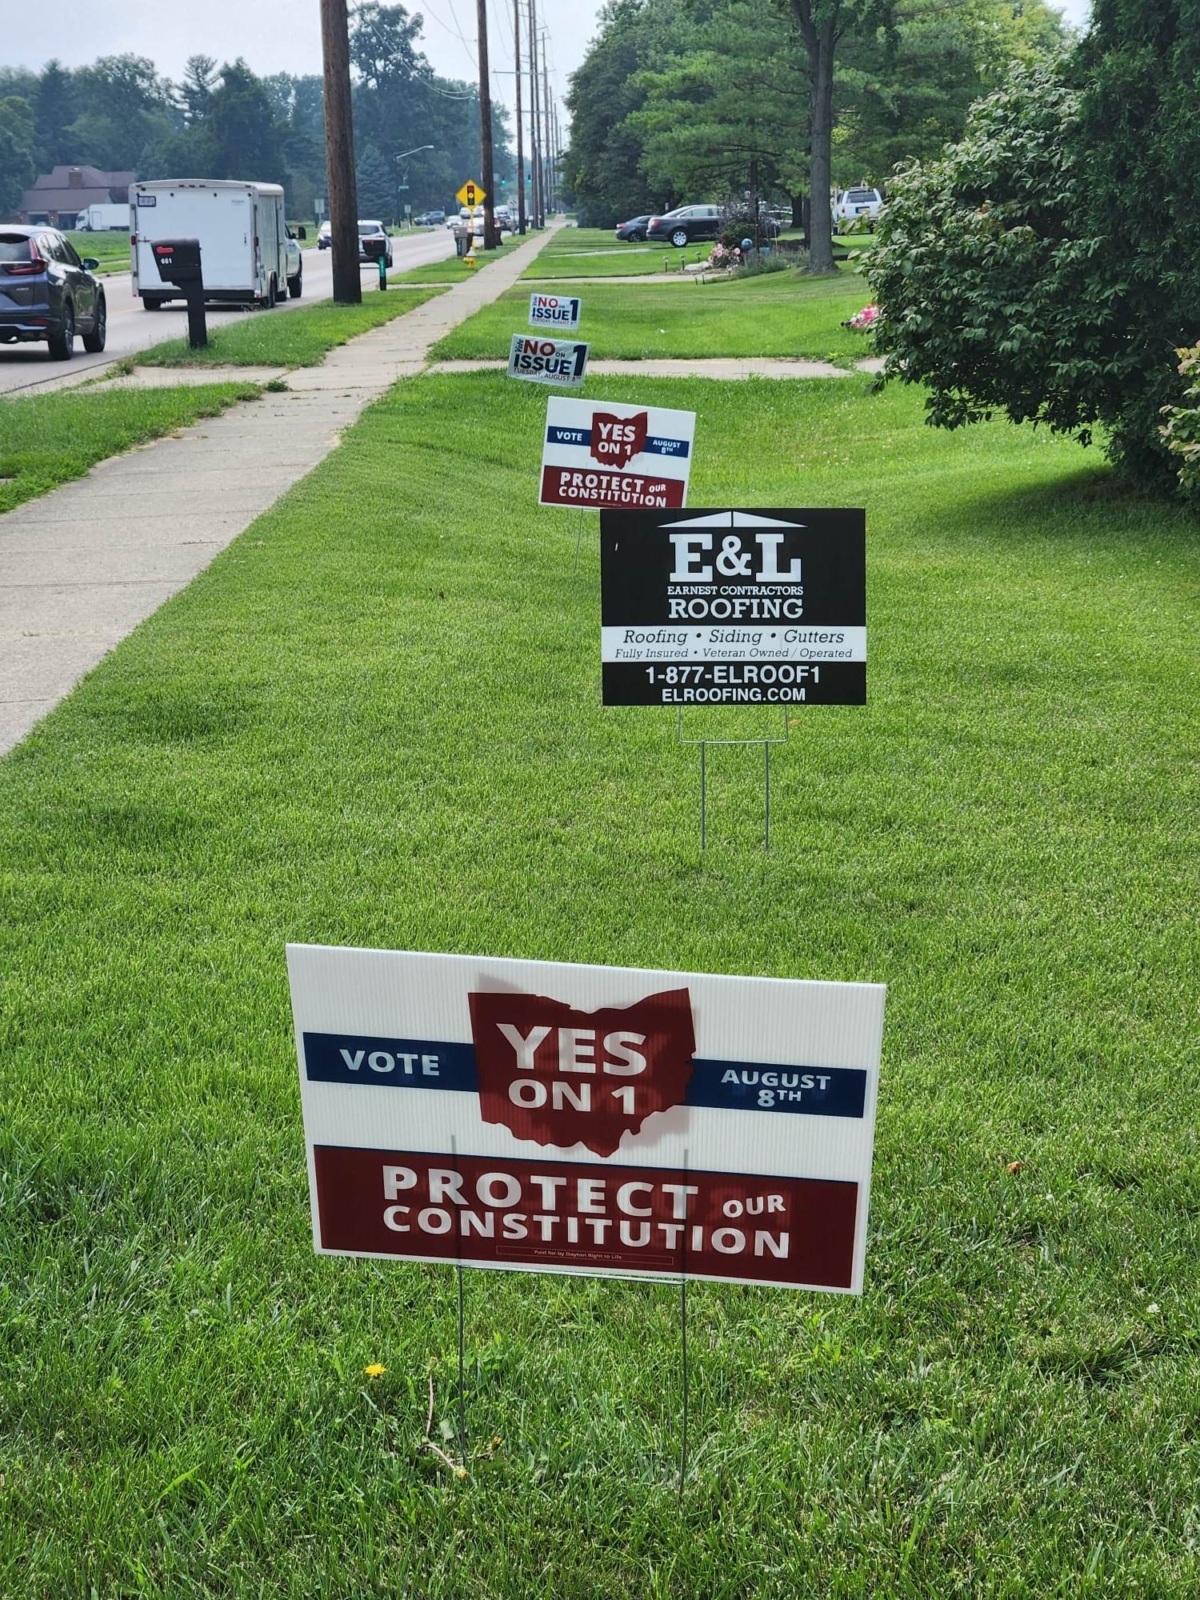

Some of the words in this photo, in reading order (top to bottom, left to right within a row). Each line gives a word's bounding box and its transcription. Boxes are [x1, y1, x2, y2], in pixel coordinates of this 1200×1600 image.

[532, 307, 570, 320] ISSUE
[570, 300, 579, 321] 1
[538, 297, 558, 308] NO
[523, 340, 555, 356] NO
[514, 354, 572, 375] ISSUE
[573, 345, 587, 376] 1
[544, 374, 569, 382] AUGUST
[556, 431, 583, 441] VOTE
[598, 423, 636, 442] YES
[598, 442, 619, 454] ON
[625, 443, 631, 455] 1
[653, 440, 681, 448] AUGUST
[560, 472, 644, 493] PROTECT
[649, 484, 666, 493] OUR
[559, 486, 667, 507] CONSTITUTION
[669, 533, 801, 582] E&L
[667, 586, 717, 595] EARNEST
[720, 586, 803, 595] CONTRACTORS
[668, 599, 803, 619] ROOFING
[623, 629, 688, 646] Roofing
[709, 629, 762, 645] Siding
[784, 630, 844, 644] Gutters
[615, 648, 643, 659] Fully
[646, 648, 688, 658] Insured
[703, 648, 746, 658] Veteran
[749, 648, 788, 658] Owned
[799, 648, 852, 659] Operated
[645, 666, 820, 684] 1-877-ELROOF1
[661, 688, 806, 702] ELROOFING.COM
[496, 1023, 647, 1076] YES
[339, 1049, 440, 1076] VOTE
[721, 1069, 831, 1090] AUGUST
[508, 1078, 591, 1112] ON
[612, 1089, 637, 1115] 1
[757, 1089, 802, 1108] 8TH
[382, 1166, 698, 1219] PROTECT
[722, 1194, 786, 1219] OUR
[382, 1205, 790, 1259] CONSTITUTION
